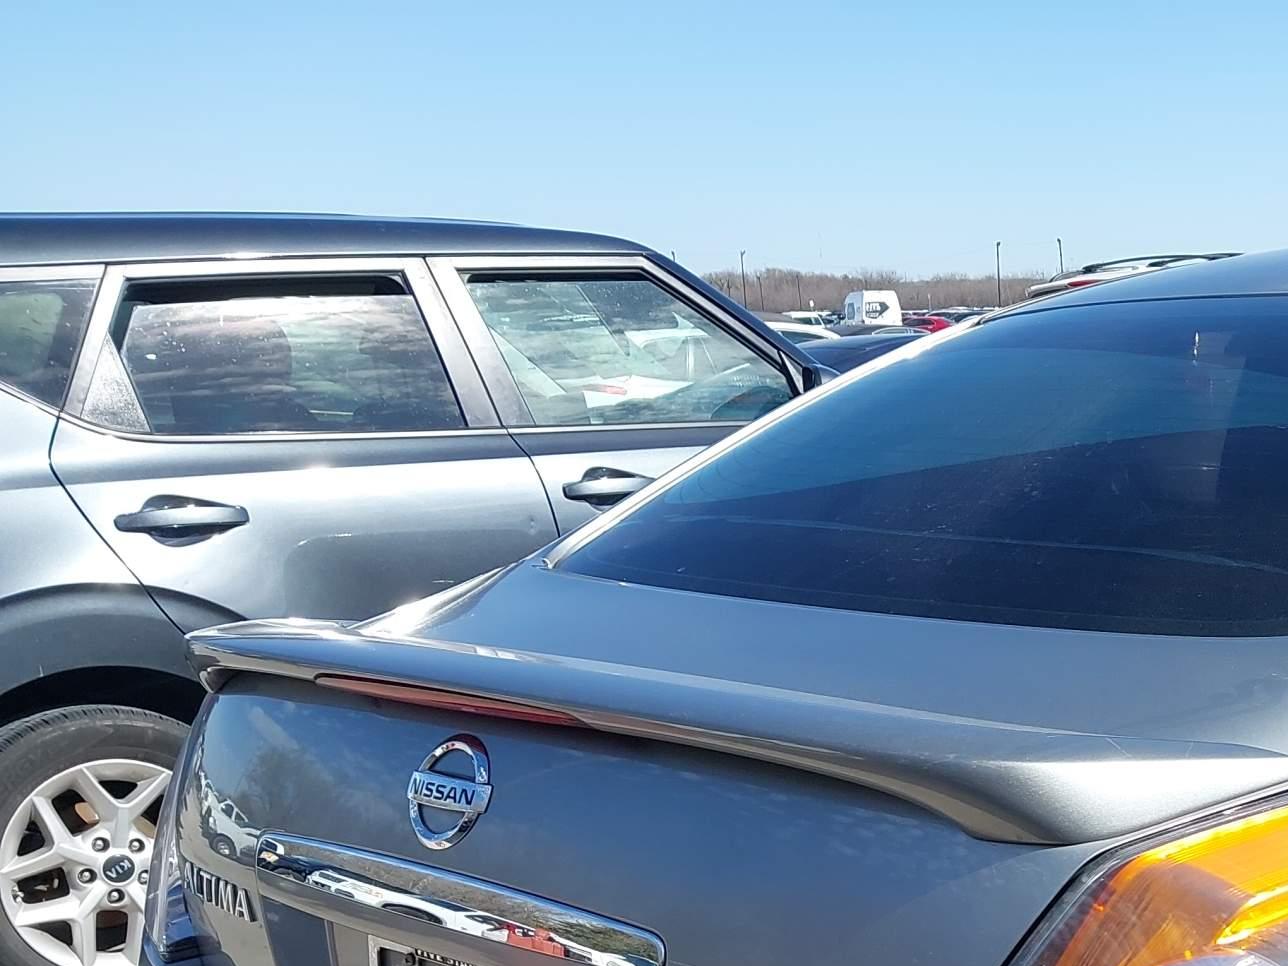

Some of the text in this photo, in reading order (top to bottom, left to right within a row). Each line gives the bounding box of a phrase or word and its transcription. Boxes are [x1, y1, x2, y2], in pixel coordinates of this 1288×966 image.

[409, 776, 477, 806] NISSAN
[105, 858, 132, 879] KIA
[183, 861, 255, 923] ALTIMA
